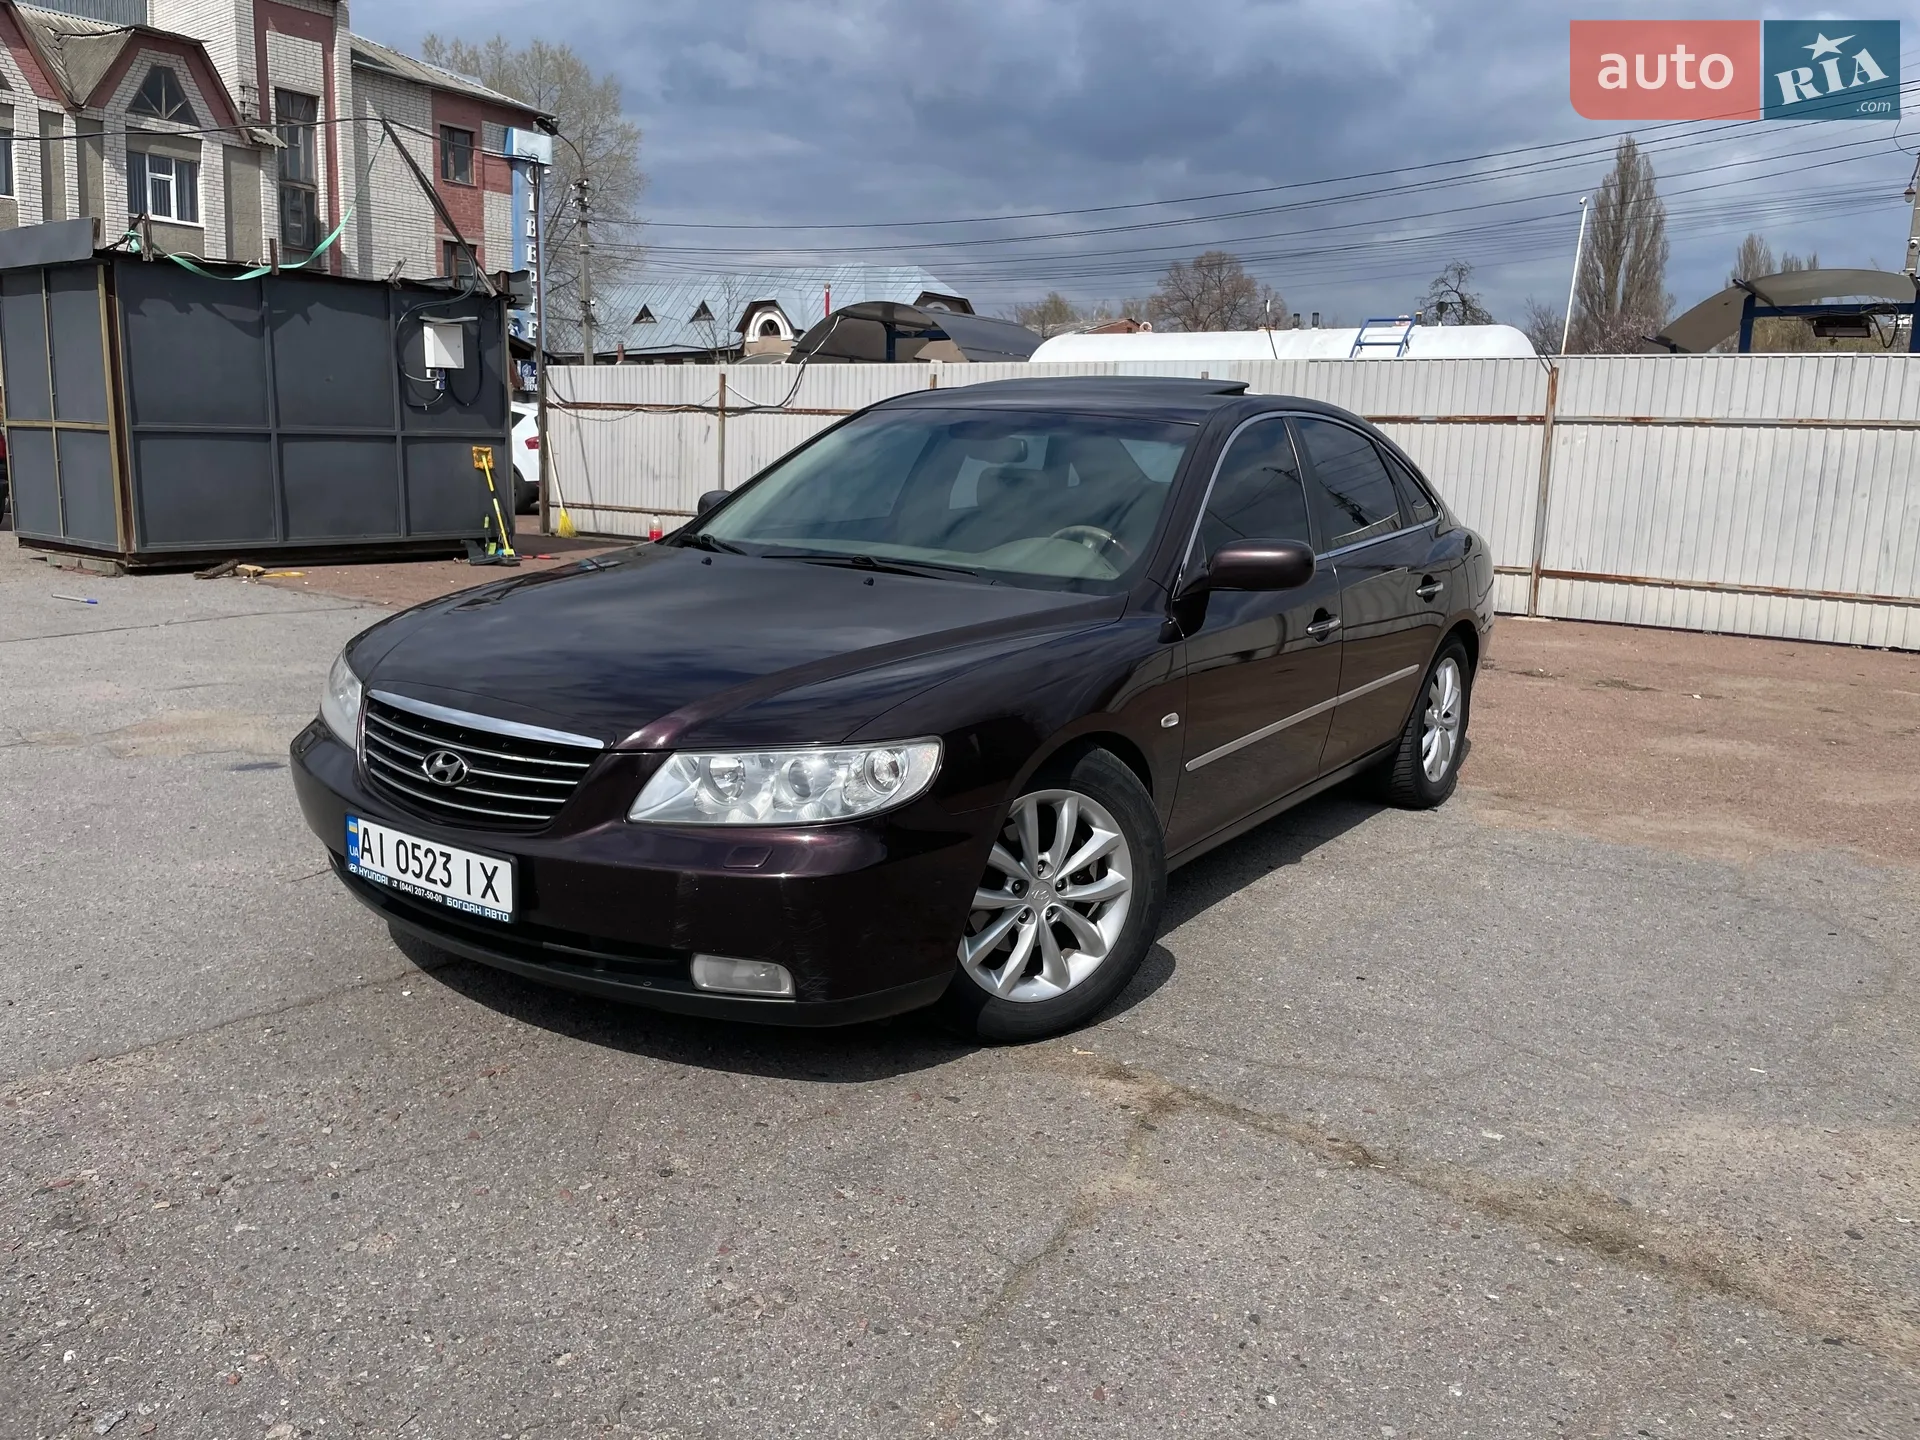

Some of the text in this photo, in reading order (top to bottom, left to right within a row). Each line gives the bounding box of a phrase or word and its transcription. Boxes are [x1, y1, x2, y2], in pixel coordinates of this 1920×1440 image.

[348, 844, 359, 858] UA
[360, 827, 500, 903] AI 0523 IX
[358, 866, 389, 885] HYUNDAI
[399, 881, 414, 895] (044)
[446, 897, 509, 922] БОГДАН АВТО
